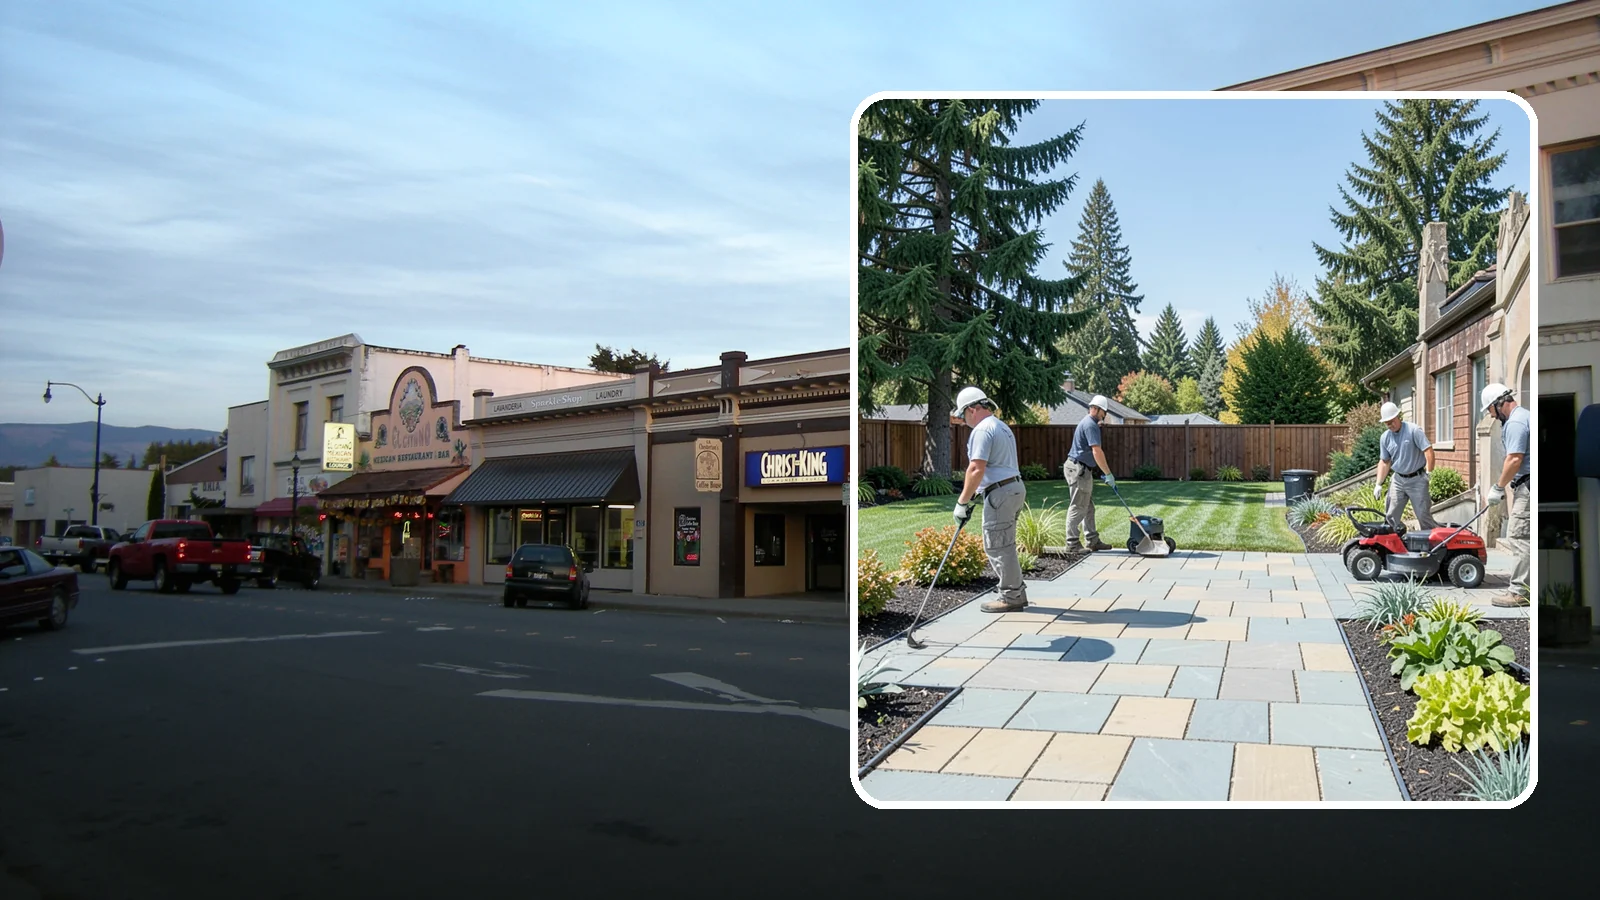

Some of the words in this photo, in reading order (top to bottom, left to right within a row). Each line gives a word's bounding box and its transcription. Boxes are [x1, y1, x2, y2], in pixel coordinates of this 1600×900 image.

[561, 394, 582, 405] Shop
[595, 389, 623, 400] LAUNDRY
[493, 402, 522, 413] LAVANDERIA
[373, 455, 396, 464] MEXICAN
[397, 451, 433, 462] RESTAURANT
[438, 450, 450, 459] BAR
[761, 452, 797, 478] CHRIST
[799, 450, 827, 476] KING
[696, 481, 709, 489] Coffee
[710, 481, 722, 489] House
